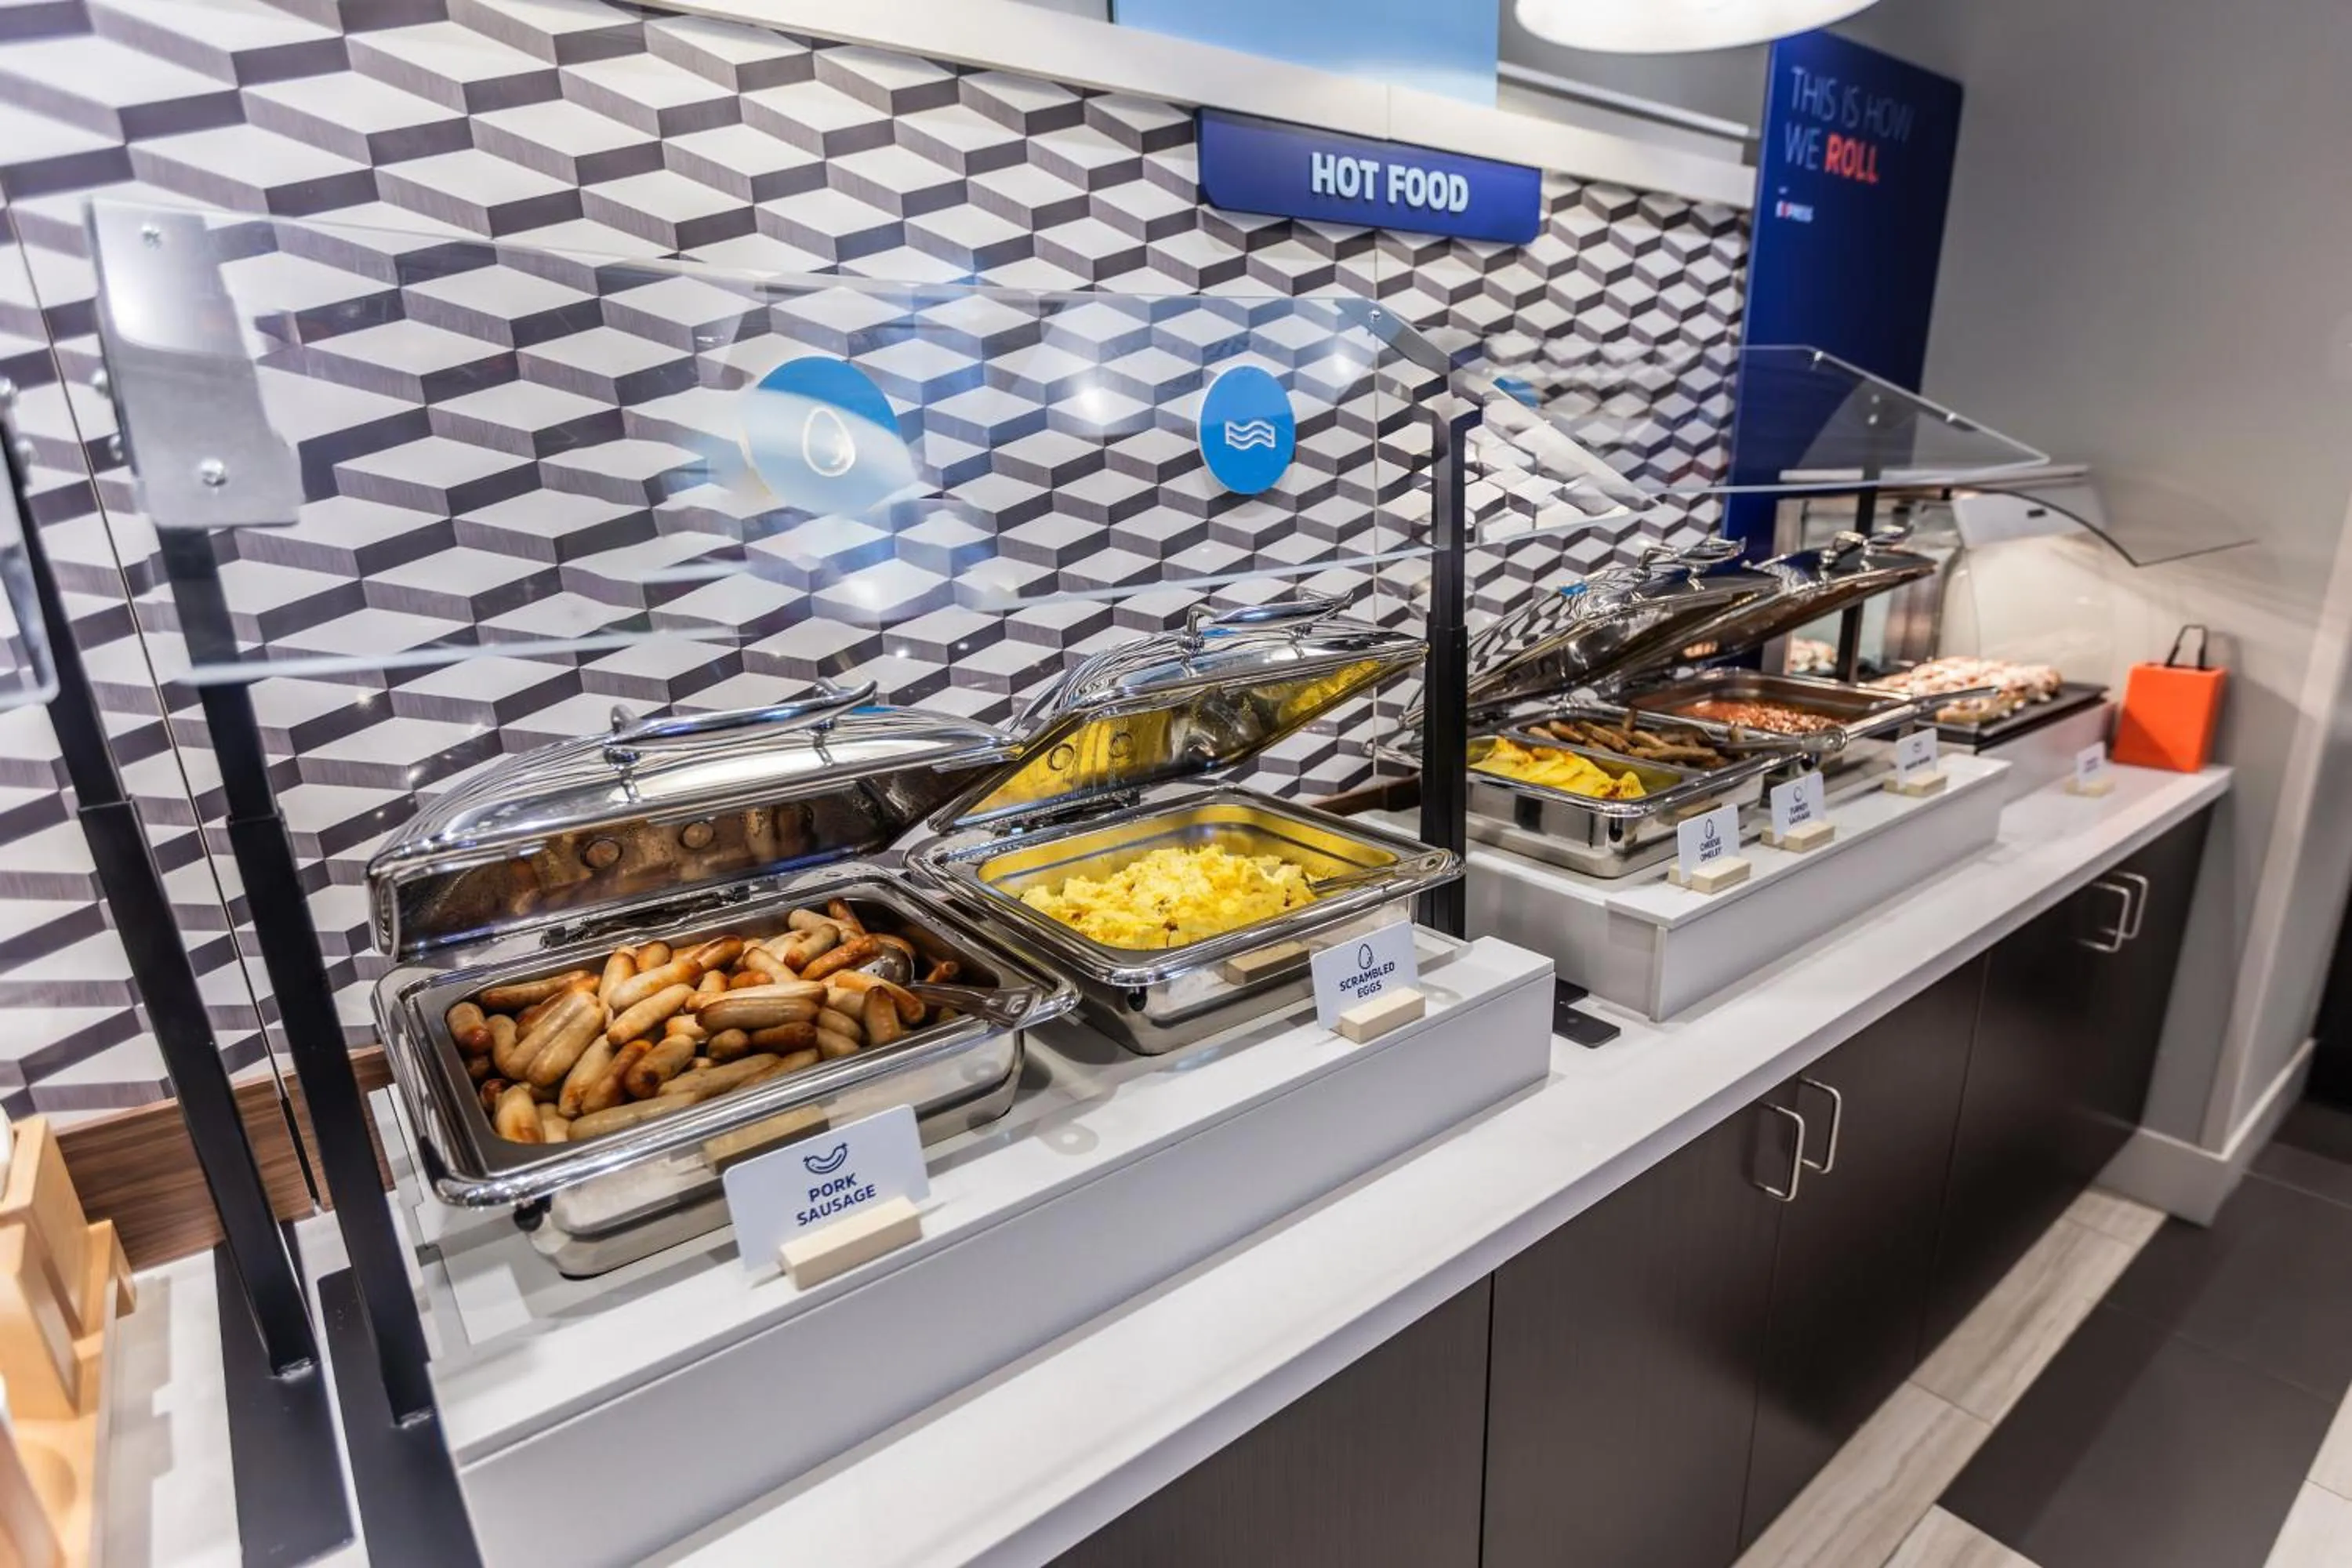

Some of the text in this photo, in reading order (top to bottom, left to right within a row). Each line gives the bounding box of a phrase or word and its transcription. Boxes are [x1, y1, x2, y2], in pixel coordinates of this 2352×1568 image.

[1791, 66, 1915, 143] THIS IS HOW
[1784, 121, 1879, 184] WE ROLL
[1311, 151, 1469, 213] HOT FOOD
[1339, 960, 1395, 992] SCRAMBLED
[1357, 981, 1382, 998] EGGS
[797, 1184, 877, 1226] SAUSAGE
[808, 1173, 857, 1202] PORK
